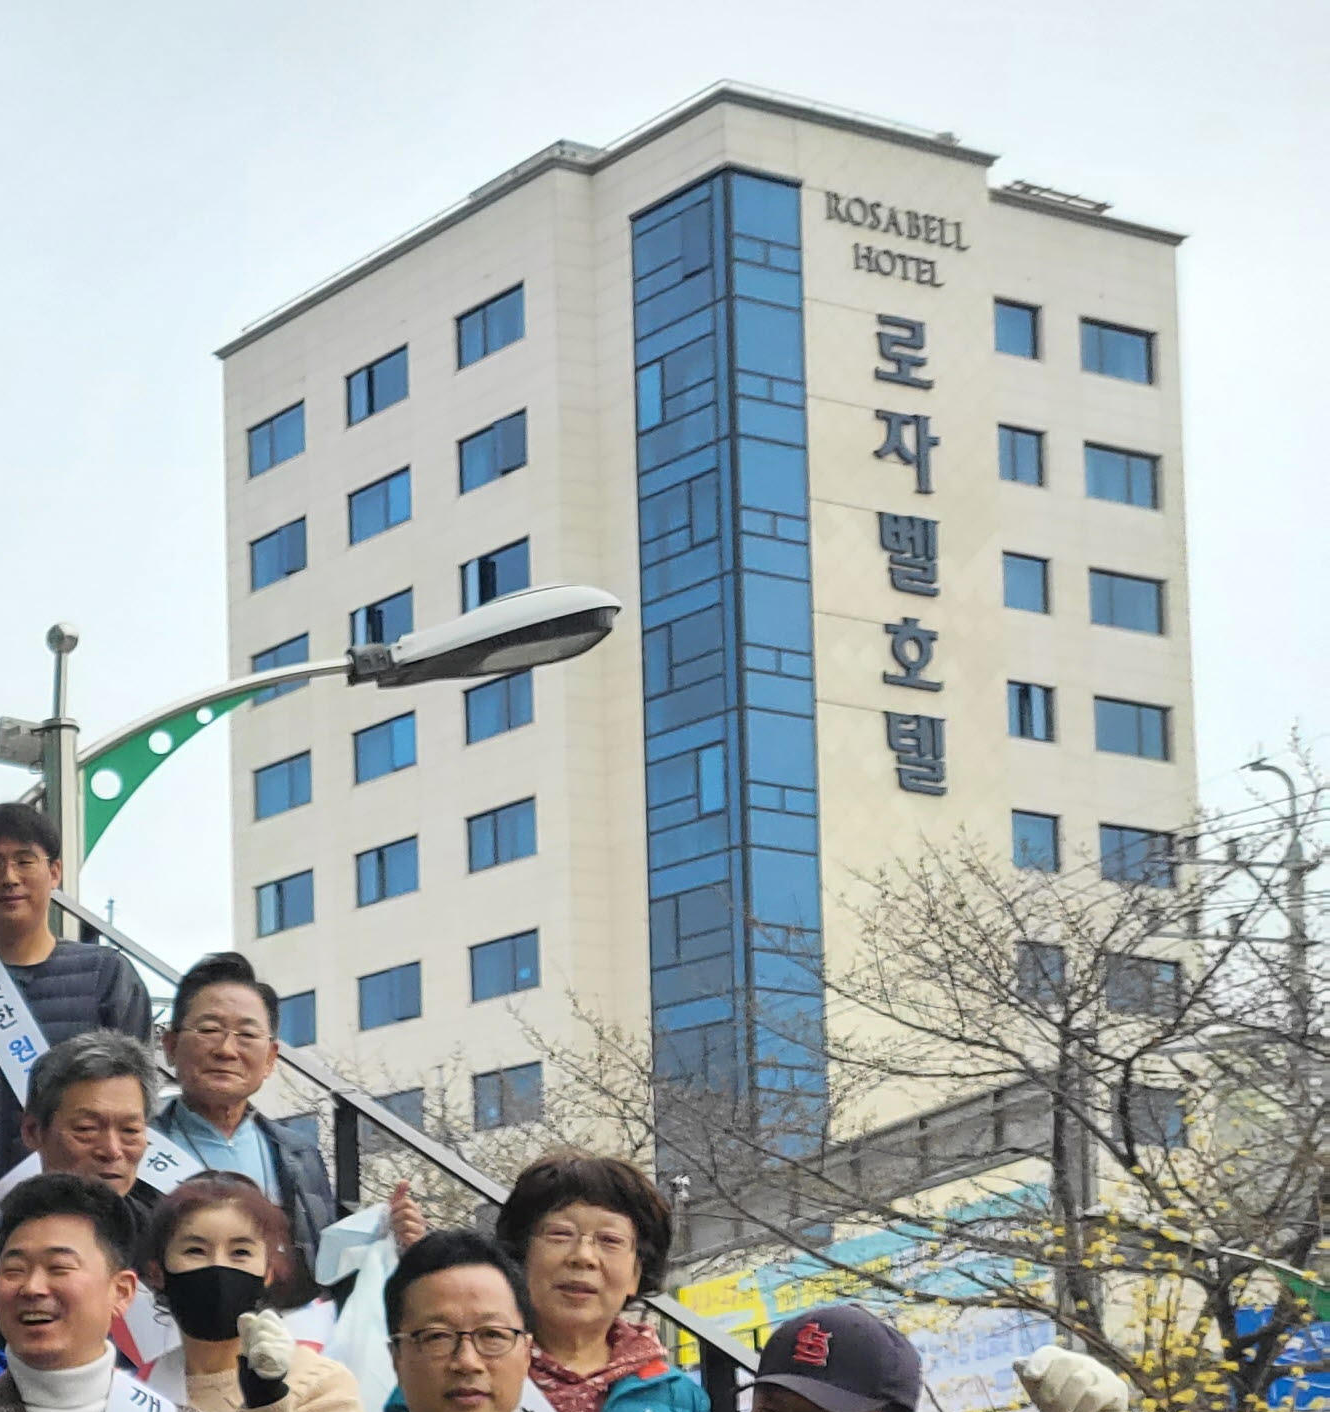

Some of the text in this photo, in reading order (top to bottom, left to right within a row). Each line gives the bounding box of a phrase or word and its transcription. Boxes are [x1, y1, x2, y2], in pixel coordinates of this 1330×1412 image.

[825, 191, 971, 252] ROSABELL
[853, 243, 945, 288] HOTEL
[873, 313, 947, 796] 로자벨호텔
[8, 1034, 34, 1073] 원
